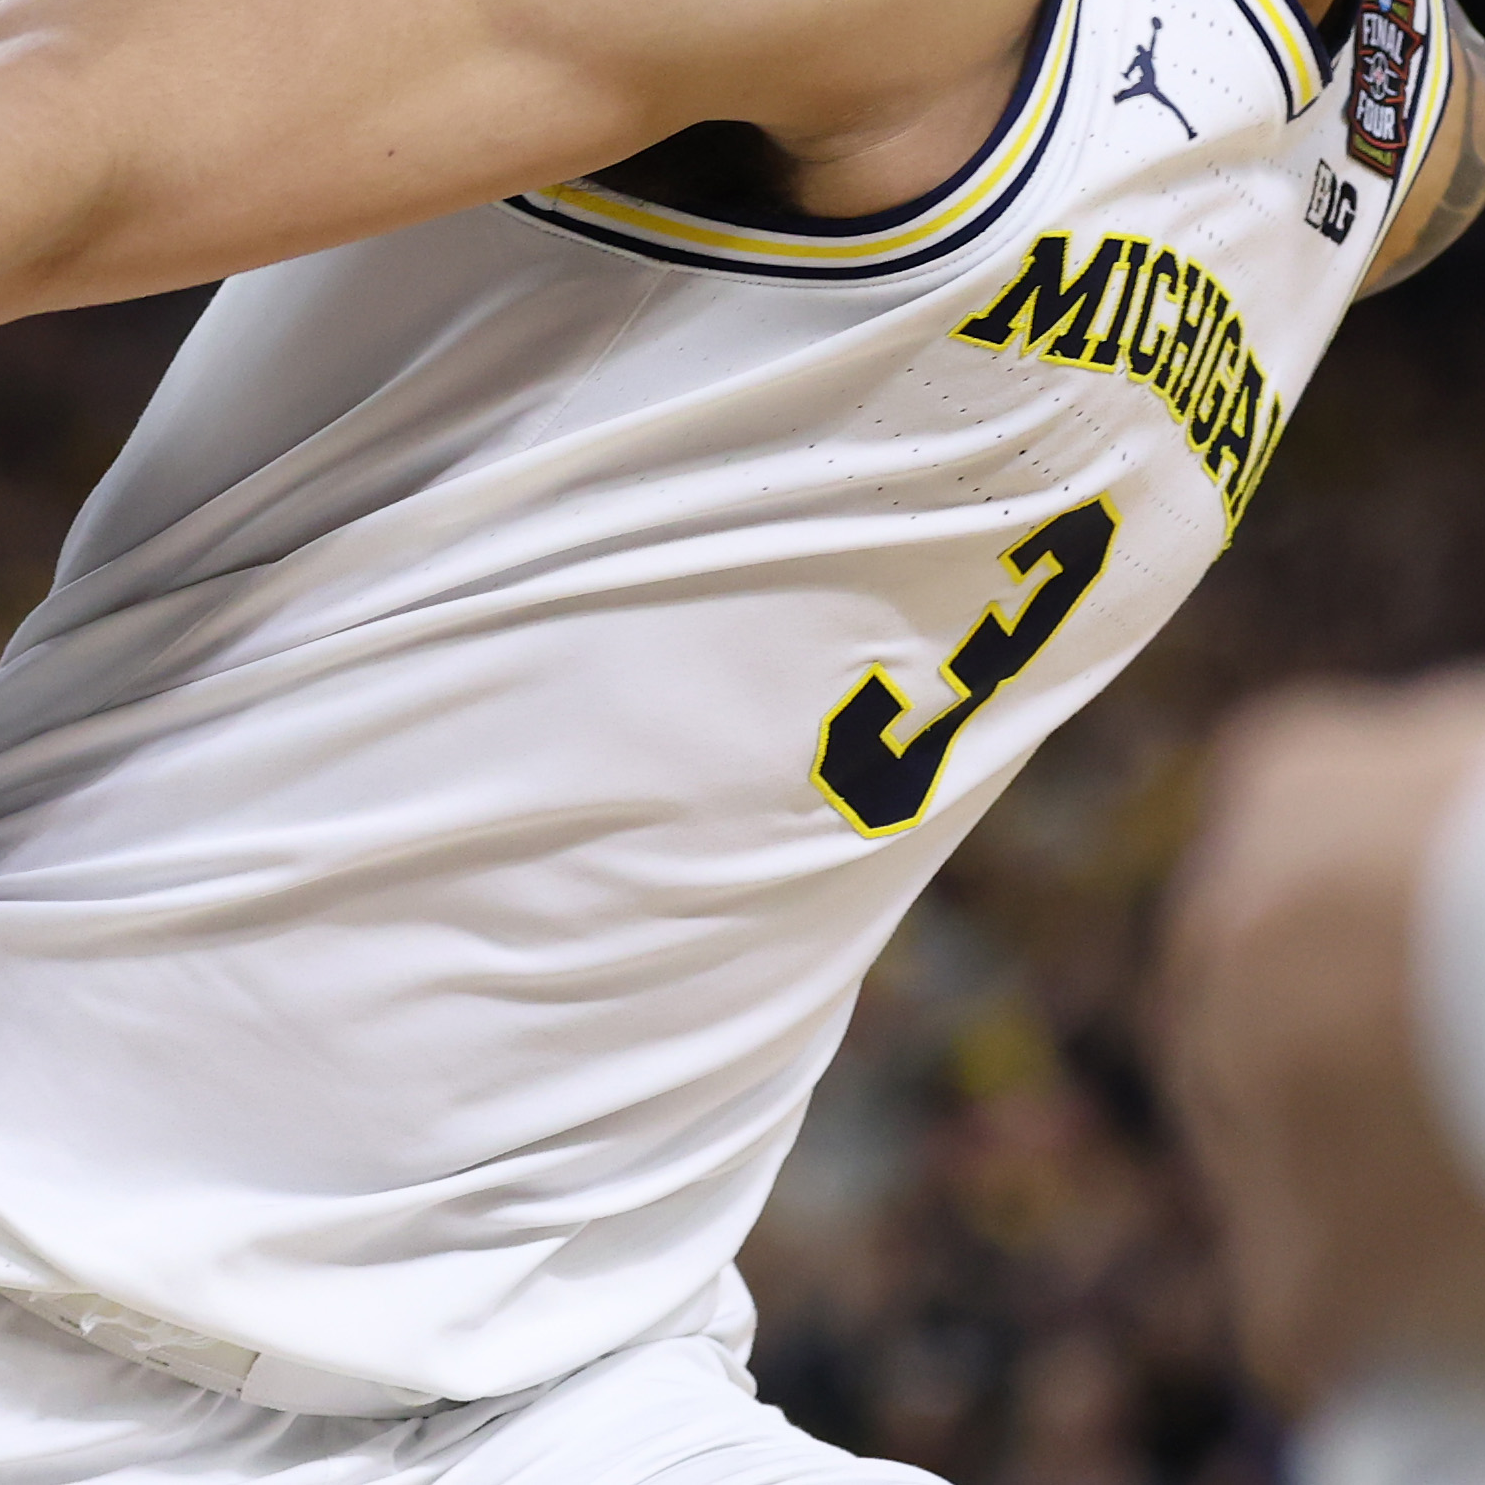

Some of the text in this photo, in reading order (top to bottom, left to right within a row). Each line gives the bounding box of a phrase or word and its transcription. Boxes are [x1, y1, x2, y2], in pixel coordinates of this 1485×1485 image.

[1362, 11, 1405, 65] FINAL
[1355, 90, 1397, 141] FOUR
[809, 490, 1123, 839] 3
